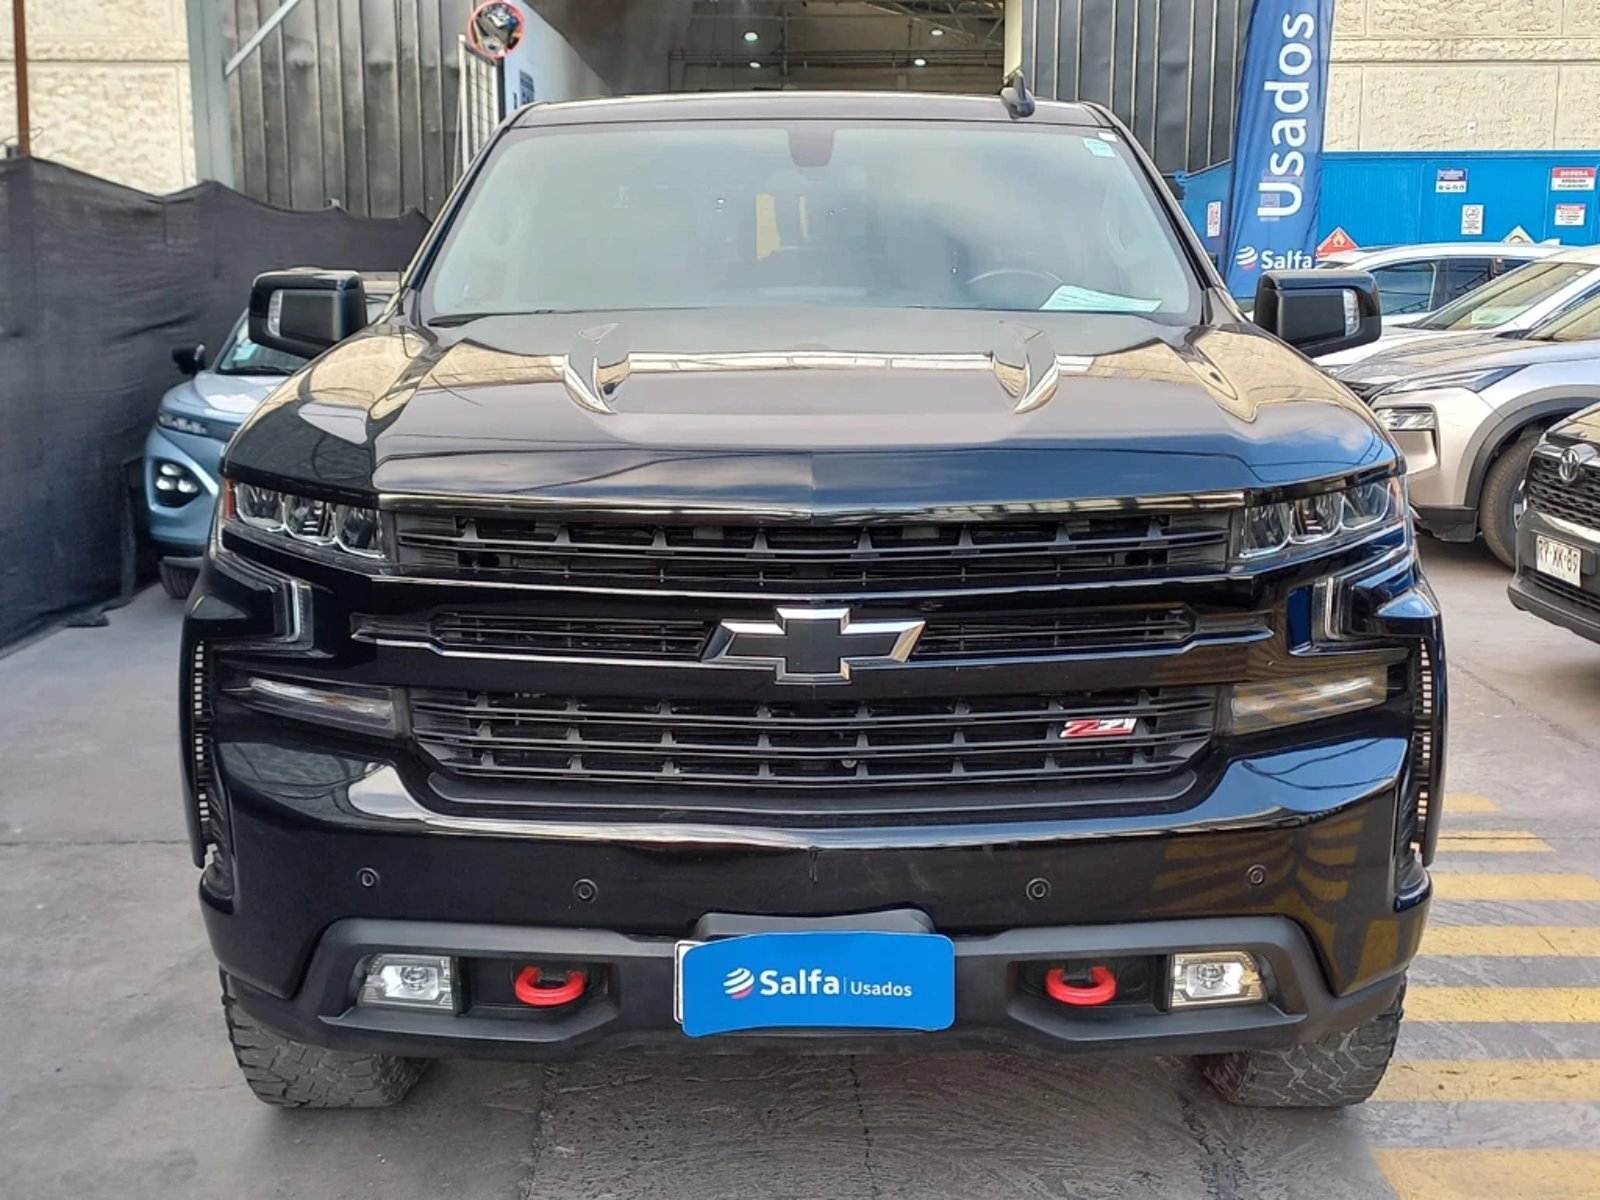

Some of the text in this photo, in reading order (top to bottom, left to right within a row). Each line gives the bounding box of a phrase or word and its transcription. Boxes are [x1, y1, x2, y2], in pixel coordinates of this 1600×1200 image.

[1257, 13, 1315, 217] Usados
[1260, 249, 1313, 270] Salfa
[1060, 718, 1137, 738] Z71
[759, 968, 912, 998] Salfa Usados
